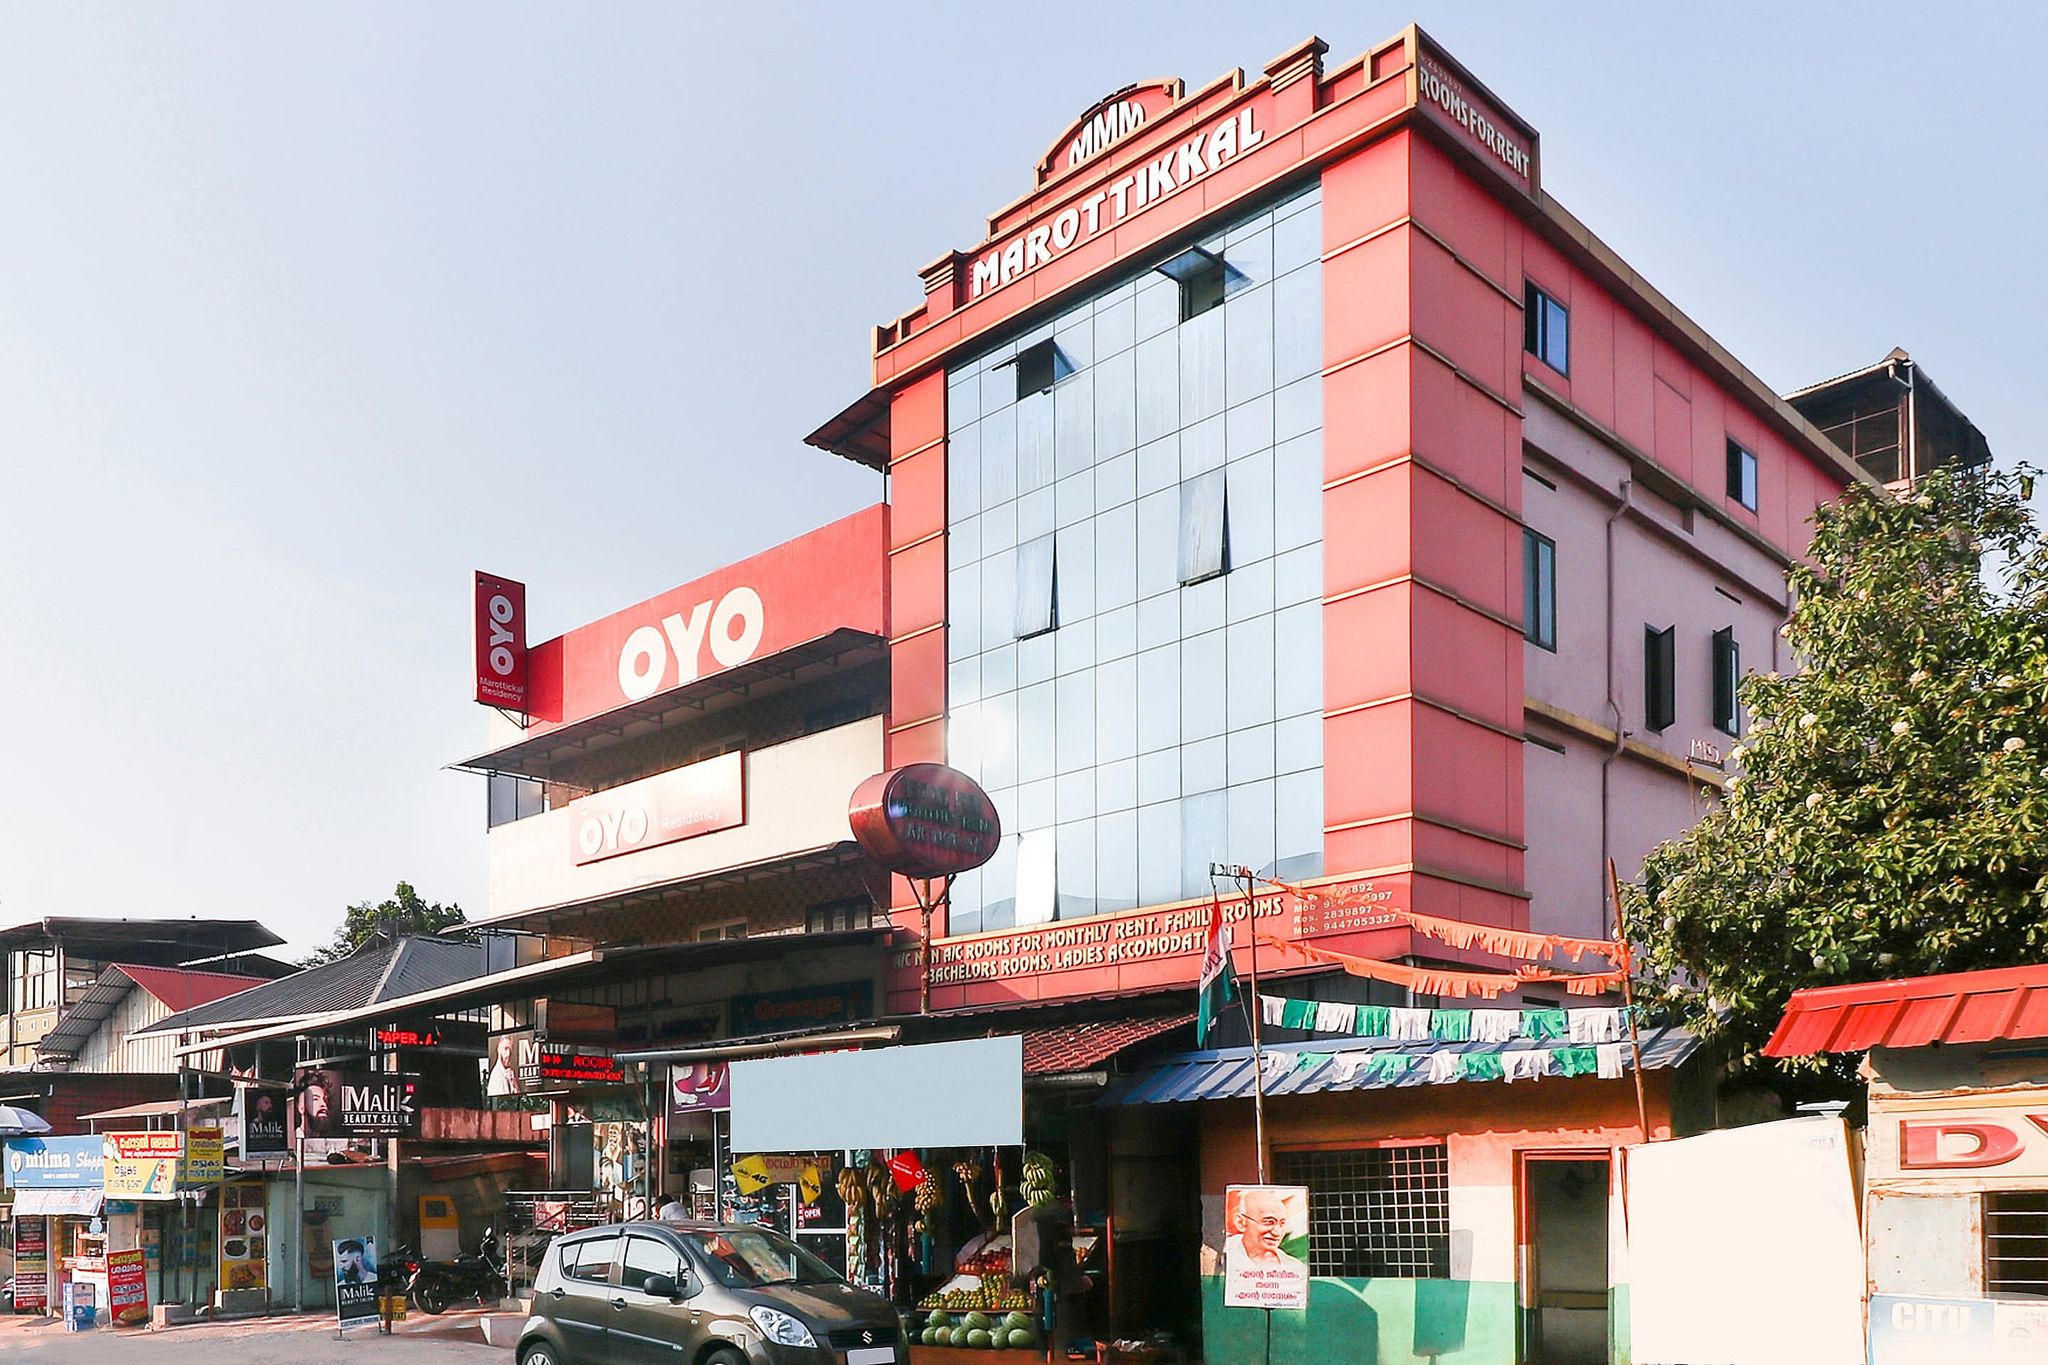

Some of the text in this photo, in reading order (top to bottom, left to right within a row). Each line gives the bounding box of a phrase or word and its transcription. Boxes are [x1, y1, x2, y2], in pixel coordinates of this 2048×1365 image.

[1420, 66, 1468, 127] ROOMS
[1470, 107, 1496, 153] FOR
[1496, 131, 1529, 178] RENT
[1069, 101, 1146, 168] MMM
[972, 108, 1265, 298] MAROTTIKKAL
[489, 594, 515, 676] OYO
[618, 586, 764, 701] OYO
[482, 685, 522, 702] Residency
[661, 809, 721, 831] Residency
[579, 806, 648, 855] OYO
[1324, 906, 1372, 920] 2839897
[1324, 914, 1397, 931] 9447053327
[915, 949, 939, 966] NN
[943, 945, 965, 963] A/C
[966, 939, 1011, 959] ROOMS
[1014, 935, 1042, 954] FOR
[1044, 924, 1112, 949] MONTHLY
[1222, 897, 1283, 923] ROOMS
[930, 960, 998, 984] BACHELORS
[1055, 947, 1104, 969] LADIES
[1108, 927, 1234, 963] ACCOMODATIN
[573, 1056, 615, 1069] ROOMS
[341, 1084, 415, 1112] Malik
[251, 1120, 284, 1134] Malik
[343, 1114, 410, 1125] BEAUTY SALON
[25, 1149, 71, 1168] milma
[751, 1173, 768, 1185] 4G
[810, 1182, 820, 1194] 4G
[804, 1207, 821, 1218] OPEN
[342, 1285, 375, 1299] Malik
[1891, 1302, 1971, 1334] CITU
